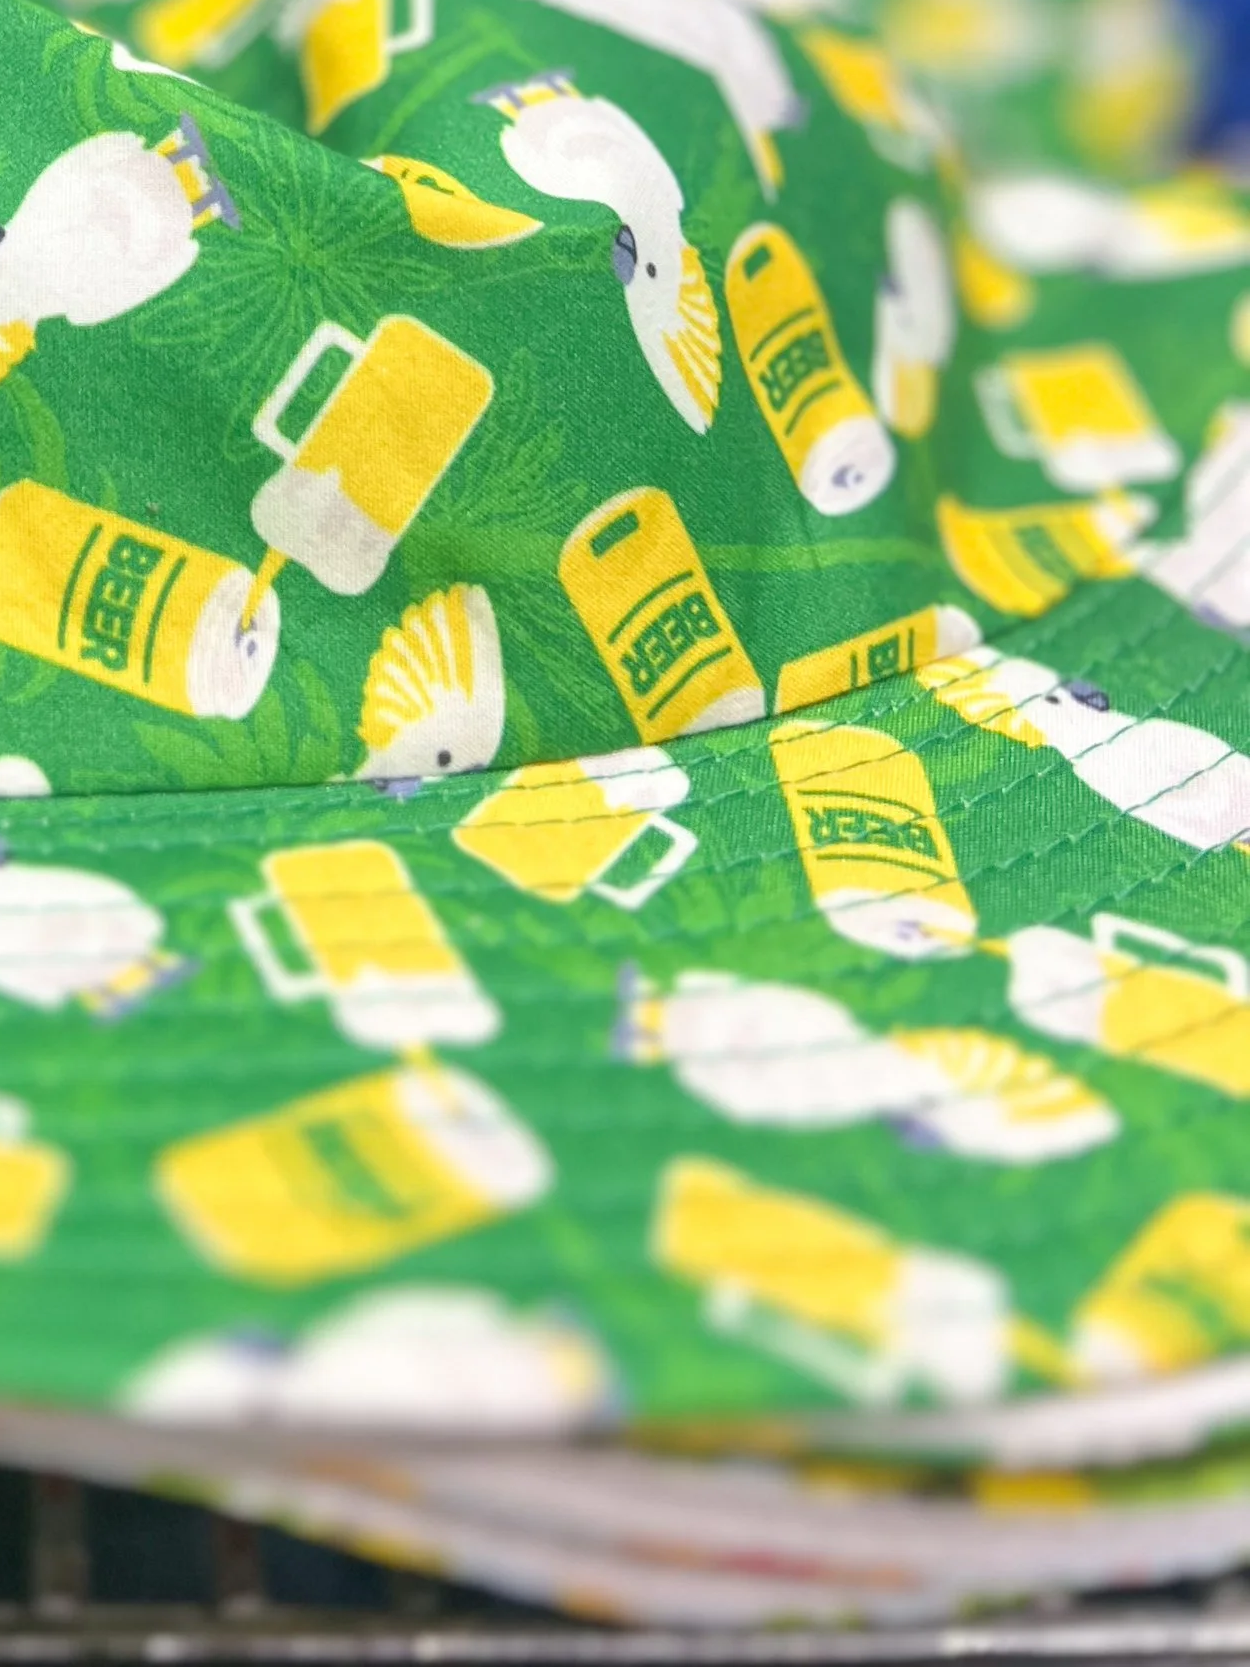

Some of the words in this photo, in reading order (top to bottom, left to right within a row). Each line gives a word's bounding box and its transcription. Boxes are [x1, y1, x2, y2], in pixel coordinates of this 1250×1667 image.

[759, 329, 829, 413] BEER
[80, 534, 166, 672] BEER
[621, 591, 722, 696] BEER
[802, 806, 943, 861] BEER
